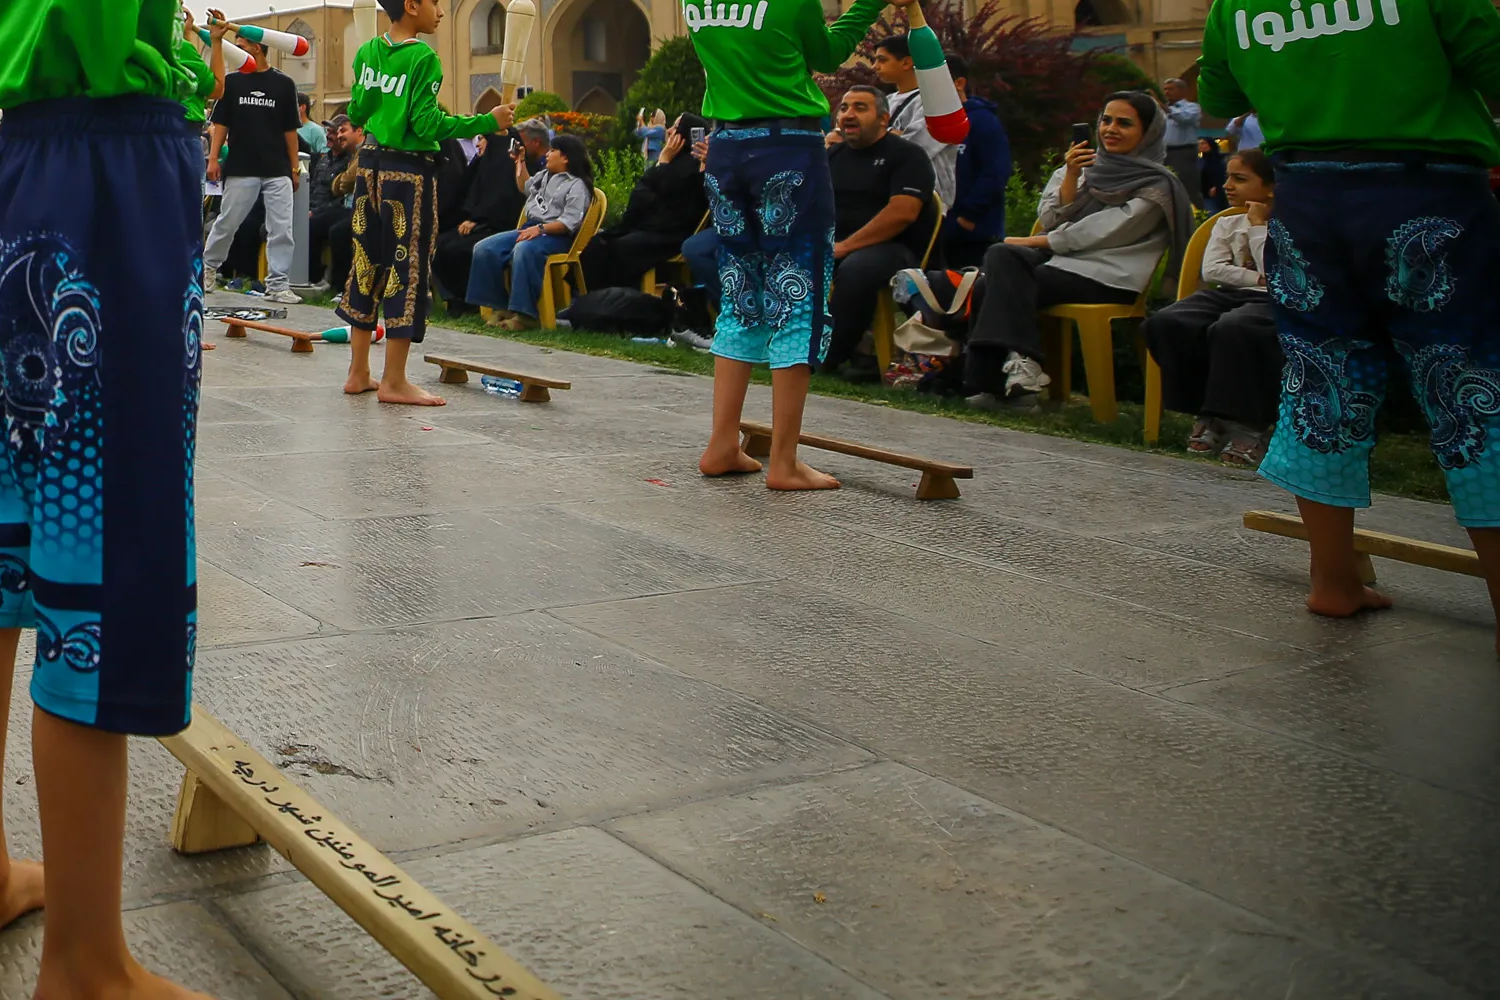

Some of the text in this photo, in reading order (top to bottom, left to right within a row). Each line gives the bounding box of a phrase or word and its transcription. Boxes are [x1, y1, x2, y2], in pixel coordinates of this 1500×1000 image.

[232, 760, 279, 793] درچه
[265, 797, 322, 825] شهر
[433, 925, 541, 1000] ورخانه
